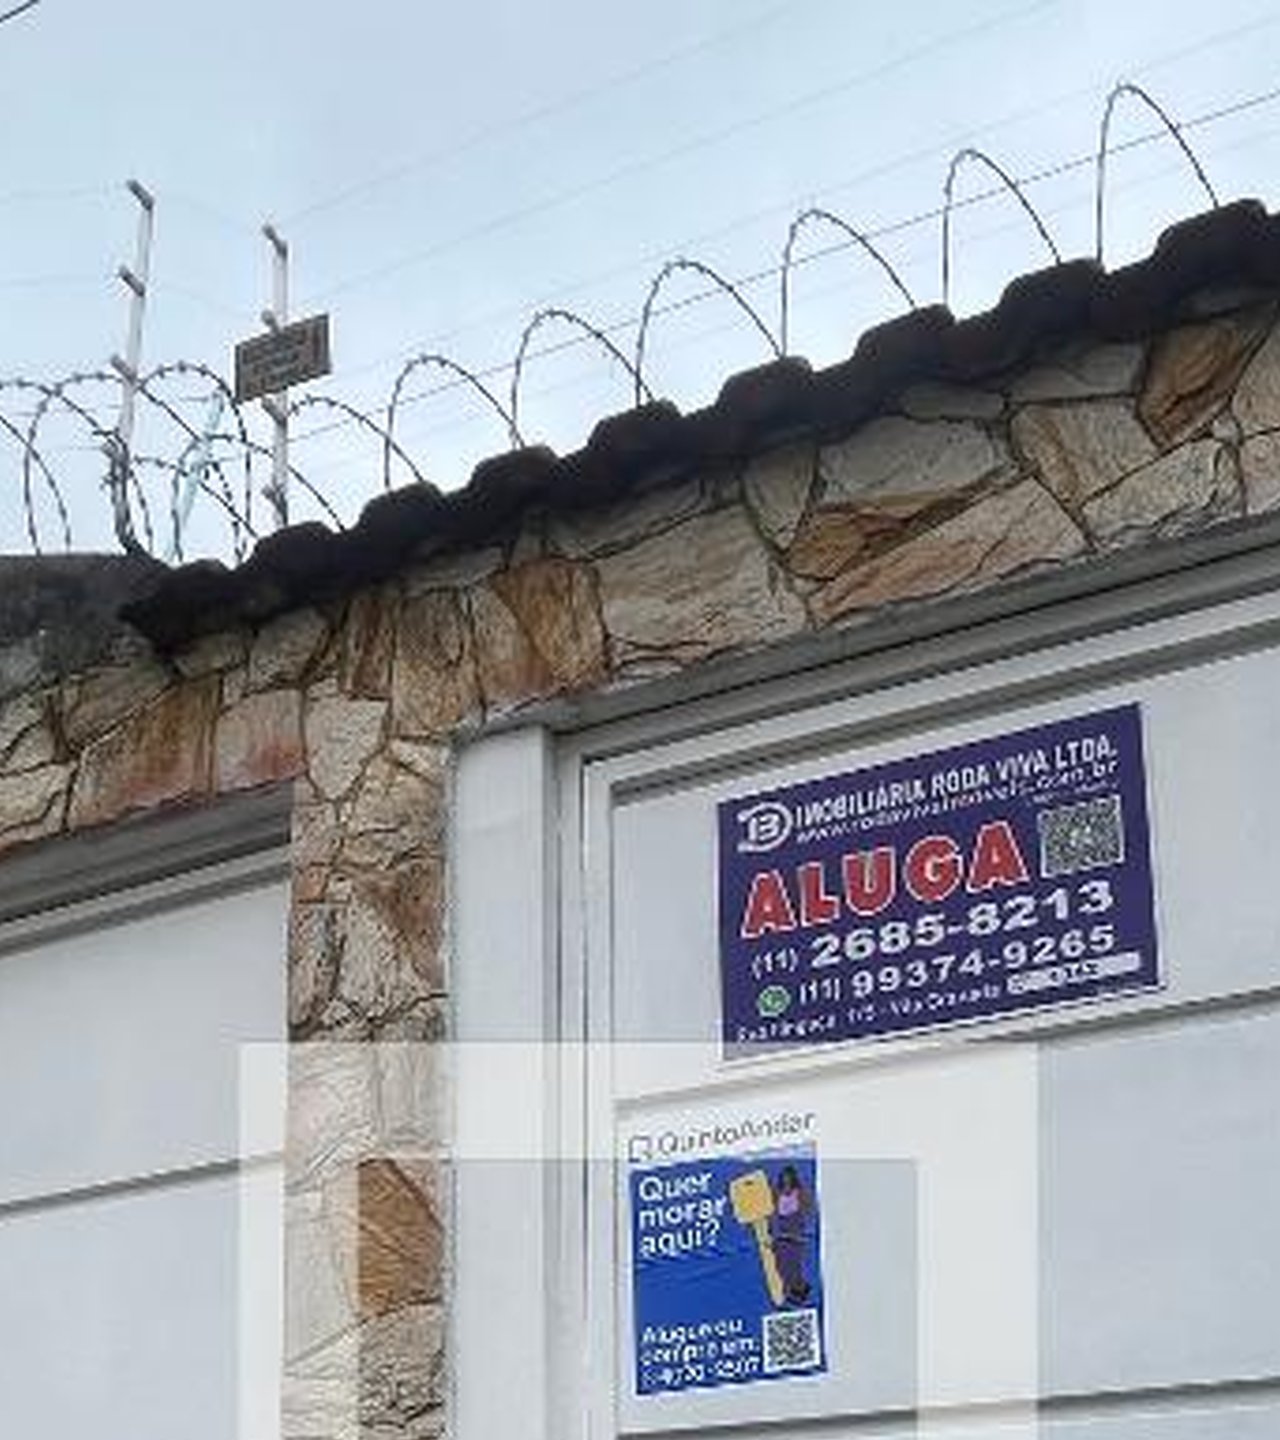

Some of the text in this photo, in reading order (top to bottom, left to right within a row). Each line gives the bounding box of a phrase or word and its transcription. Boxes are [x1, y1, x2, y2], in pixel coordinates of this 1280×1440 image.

[930, 764, 990, 796] RODA
[996, 750, 1048, 782] VIVA
[741, 820, 1030, 939] ALUGA
[751, 880, 1115, 980] (11) 2685-8213
[851, 924, 1116, 999] 99374-9265
[638, 1171, 713, 1202] Quer
[639, 1197, 727, 1228] morar
[641, 1219, 720, 1258] aqui?
